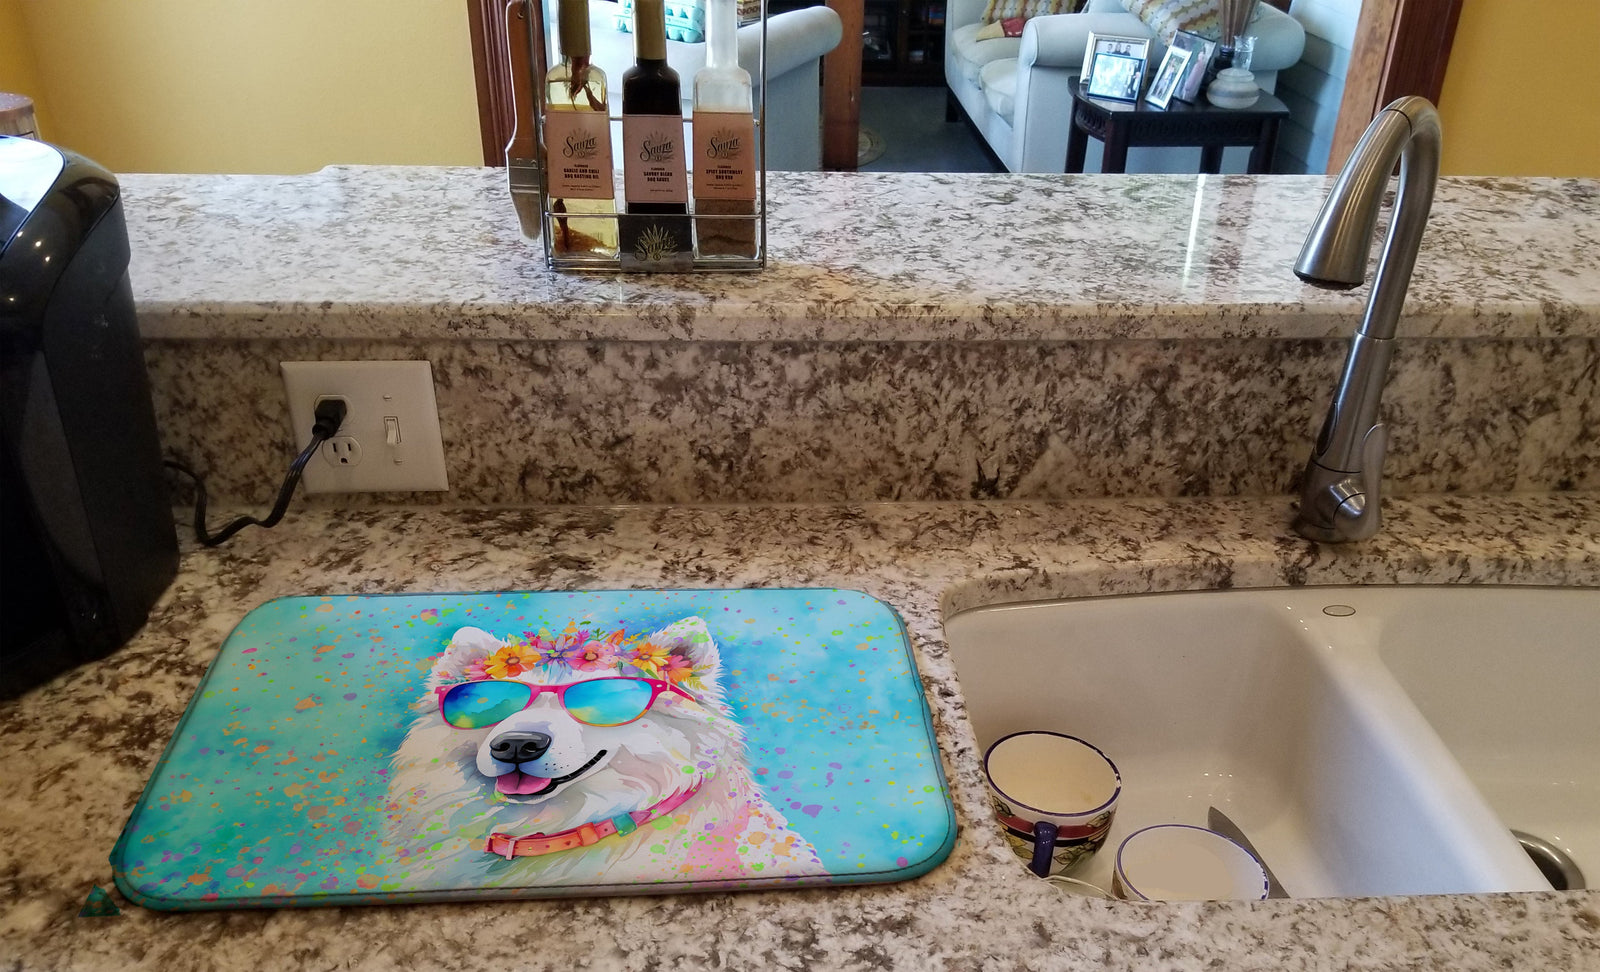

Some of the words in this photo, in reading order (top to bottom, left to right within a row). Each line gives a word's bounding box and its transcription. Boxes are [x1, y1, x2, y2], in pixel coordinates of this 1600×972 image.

[563, 136, 596, 157] Sauza
[640, 140, 673, 161] Sauza
[707, 137, 739, 158] Sauza
